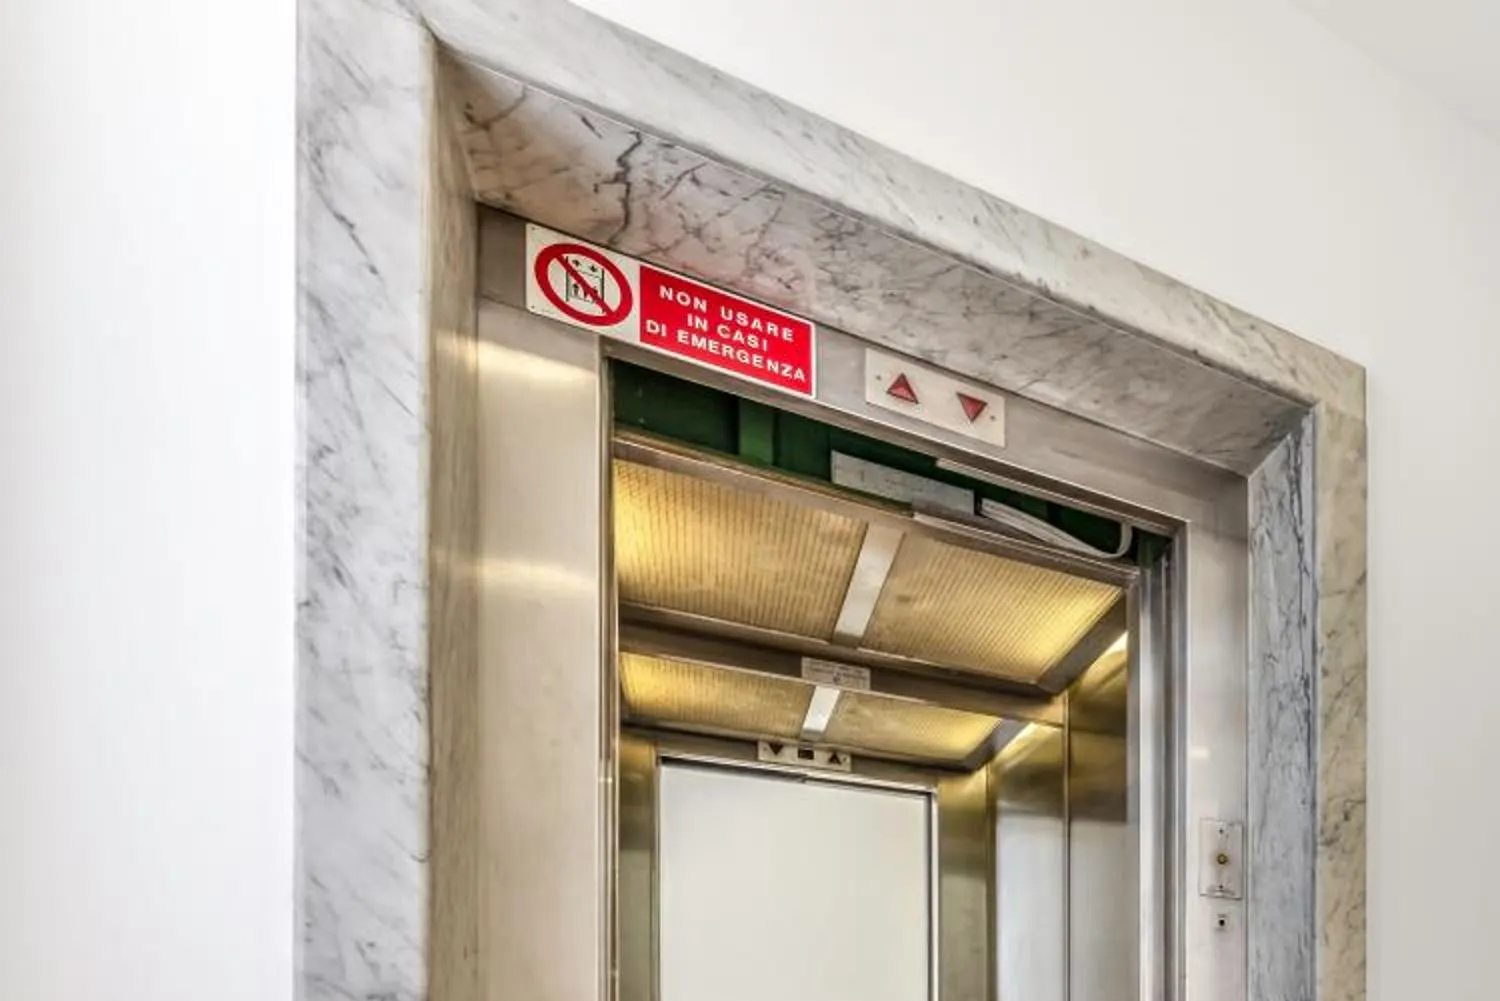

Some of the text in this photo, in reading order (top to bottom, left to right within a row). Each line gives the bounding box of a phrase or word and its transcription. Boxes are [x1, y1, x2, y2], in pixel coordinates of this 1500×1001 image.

[659, 285, 794, 342] NON USARE
[687, 314, 768, 352] IN CASI
[646, 319, 806, 382] DI EMERGENZA
